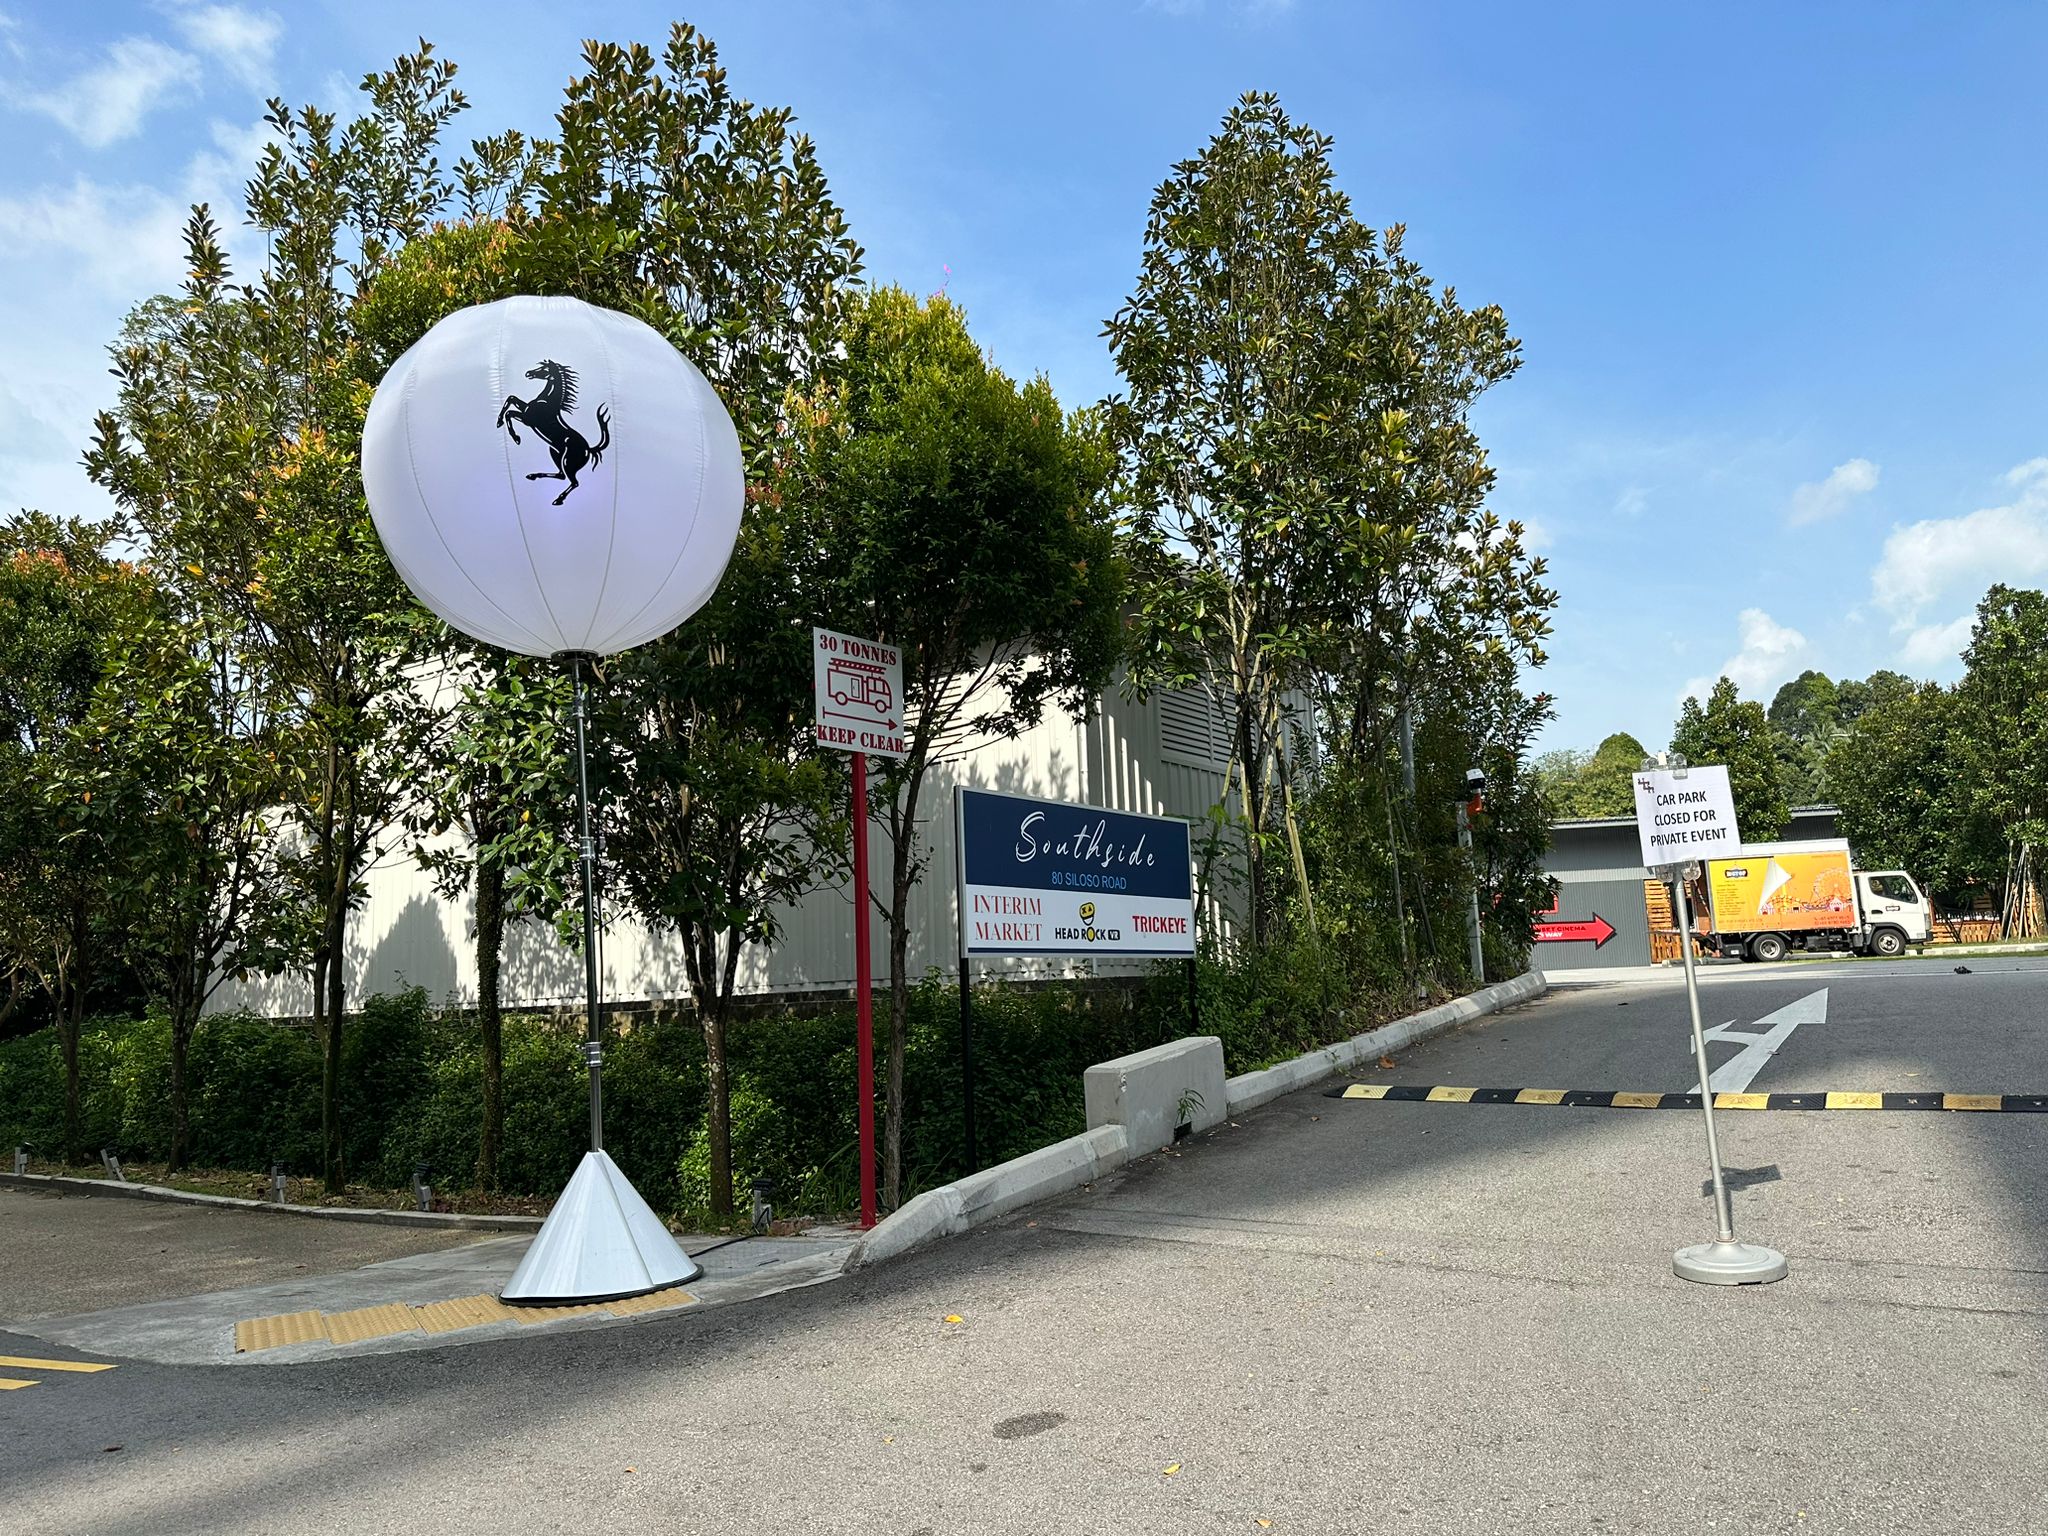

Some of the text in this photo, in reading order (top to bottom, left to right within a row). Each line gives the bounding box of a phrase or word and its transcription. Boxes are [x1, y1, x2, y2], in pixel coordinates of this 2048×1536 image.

[820, 634, 897, 666] 30 TONNES
[817, 724, 904, 753] KEEP CLEAR
[1656, 791, 1707, 806] CAR PARK
[1654, 809, 1717, 827] CLOSED FOR
[1015, 811, 1156, 868] Southside
[1650, 828, 1727, 847] PRIVATE EVENT
[1051, 871, 1127, 890] 80 SILOSO ROAD
[974, 895, 1042, 916] INTERIM
[975, 921, 1043, 941] MARKET
[1132, 915, 1187, 934] TRICKEYE
